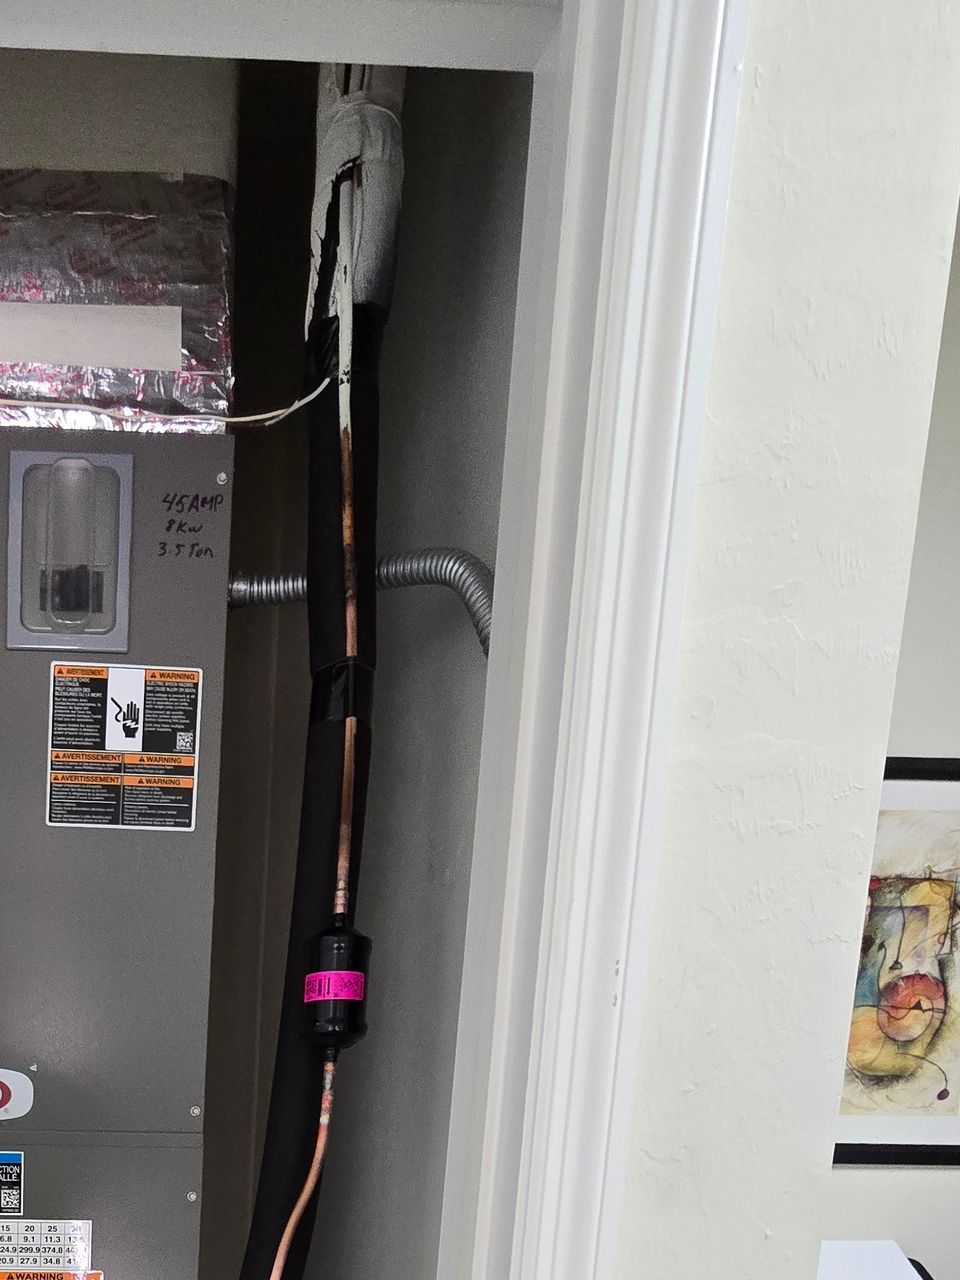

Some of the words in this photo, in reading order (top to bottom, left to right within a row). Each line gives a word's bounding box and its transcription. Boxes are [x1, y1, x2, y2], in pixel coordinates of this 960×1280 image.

[62, 753, 120, 761] AVERTISSEMENT
[147, 756, 182, 764] WARNING
[61, 775, 120, 783] AVERTISSEMENT
